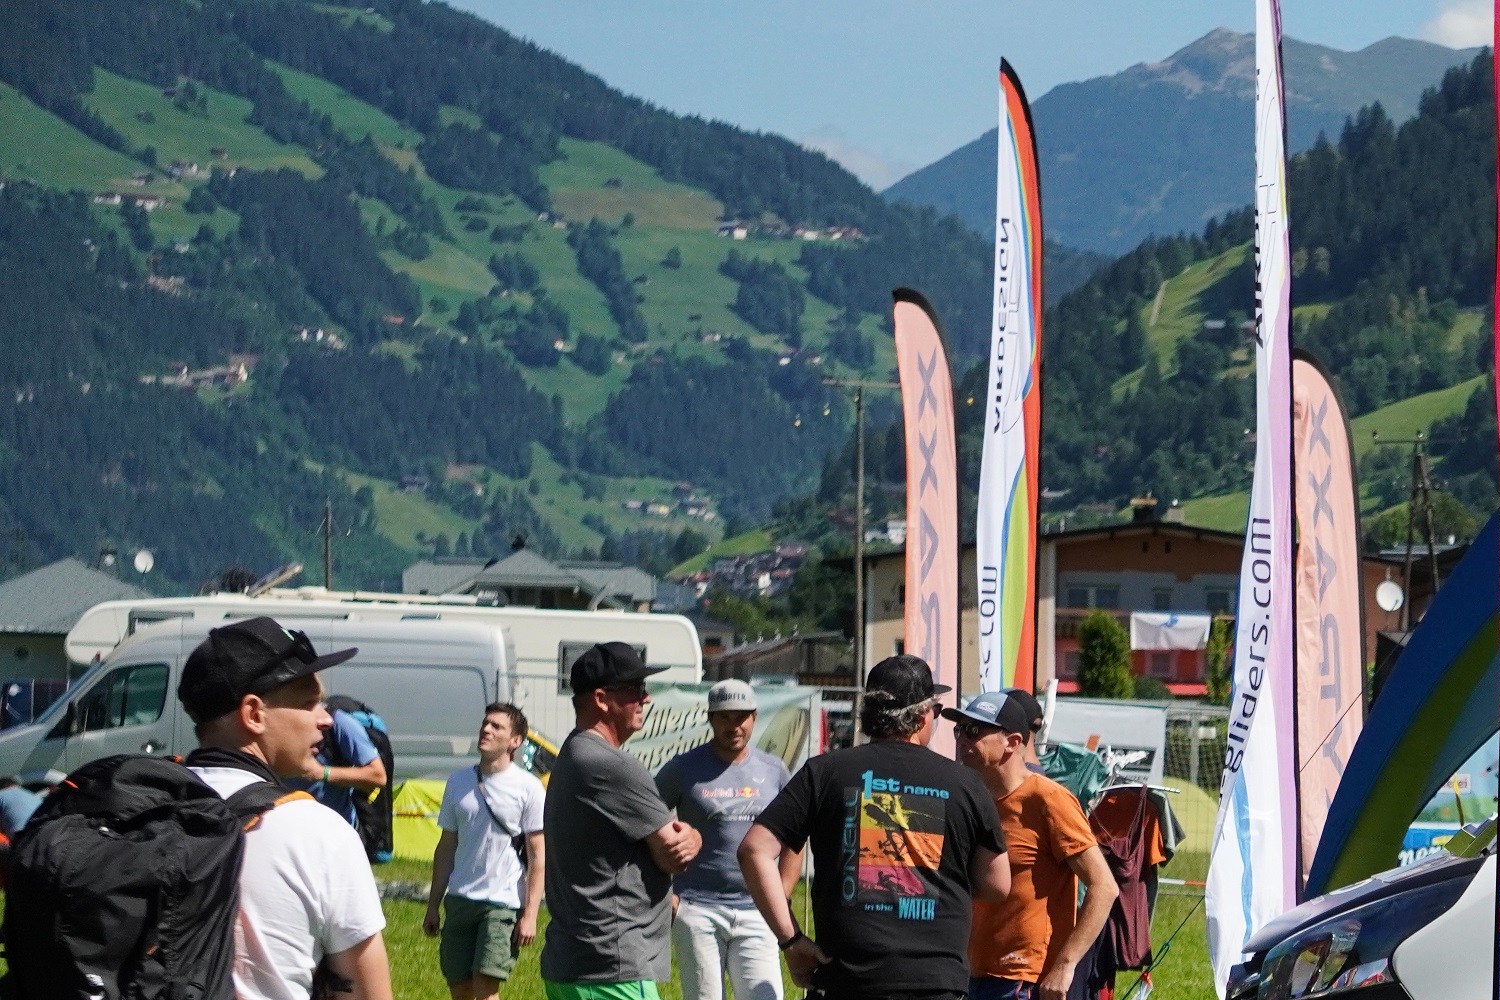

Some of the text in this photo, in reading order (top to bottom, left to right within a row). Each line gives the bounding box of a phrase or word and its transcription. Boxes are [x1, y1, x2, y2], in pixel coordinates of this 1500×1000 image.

[861, 769, 950, 800] 1st name
[899, 898, 936, 920] WATER
